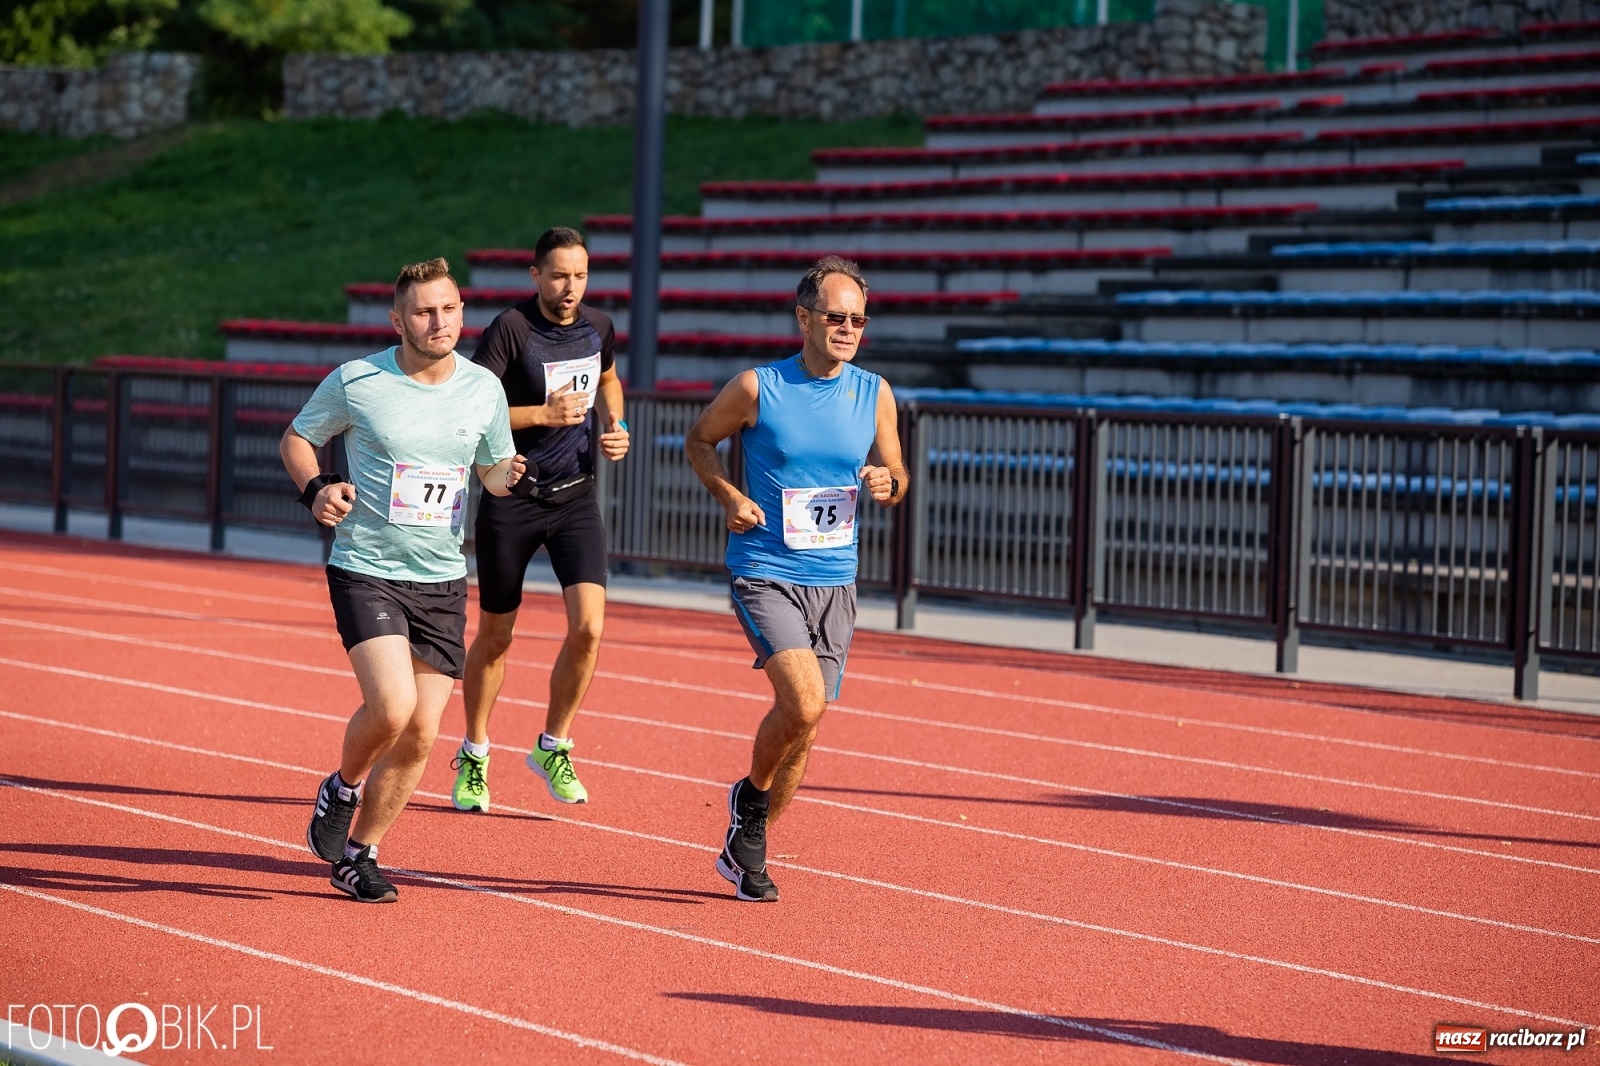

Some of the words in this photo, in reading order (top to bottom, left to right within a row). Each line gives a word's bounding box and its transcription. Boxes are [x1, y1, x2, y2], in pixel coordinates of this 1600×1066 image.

[572, 373, 589, 391] 19
[424, 483, 447, 504] 77
[813, 505, 837, 526] 75
